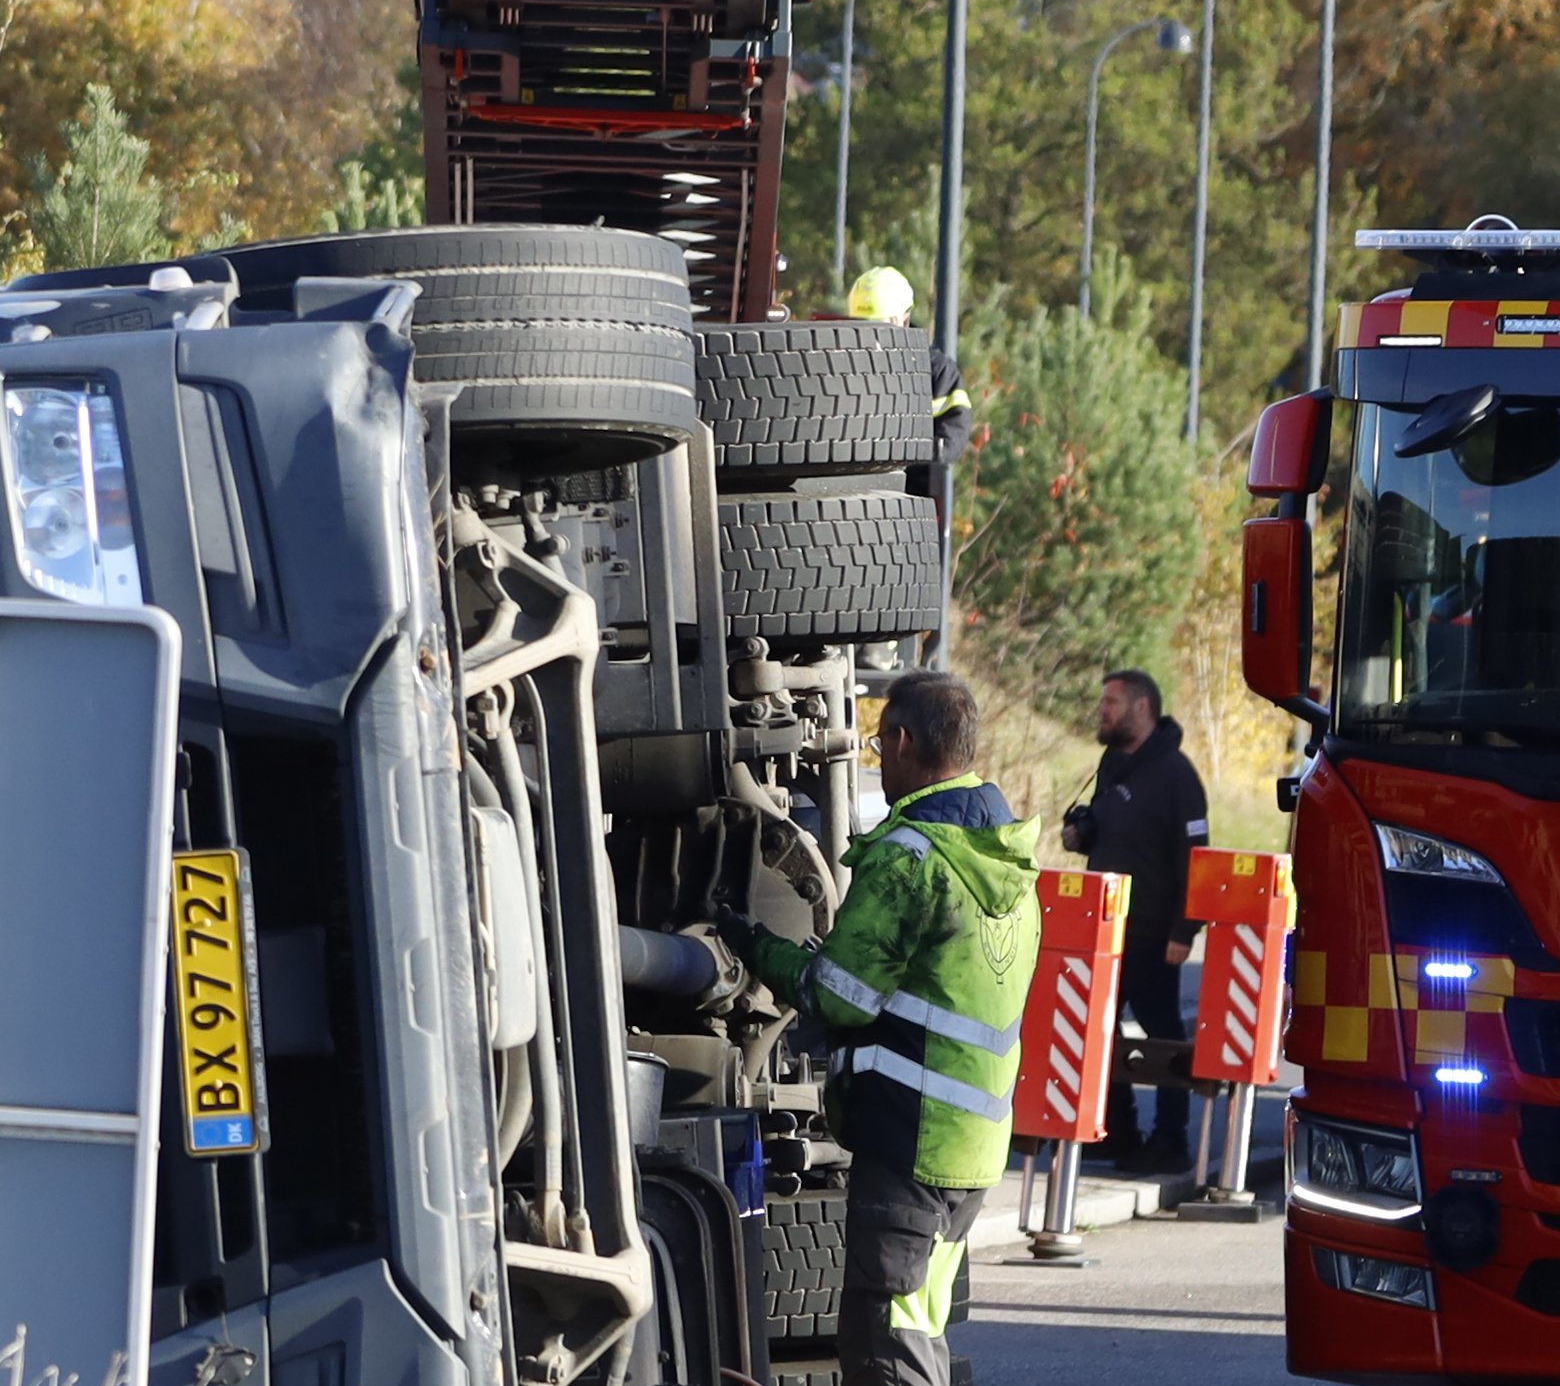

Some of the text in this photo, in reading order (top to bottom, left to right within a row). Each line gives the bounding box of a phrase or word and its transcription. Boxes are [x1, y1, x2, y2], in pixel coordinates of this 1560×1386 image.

[180, 864, 241, 1112] BX 97 727
[227, 1122, 243, 1143] DK
